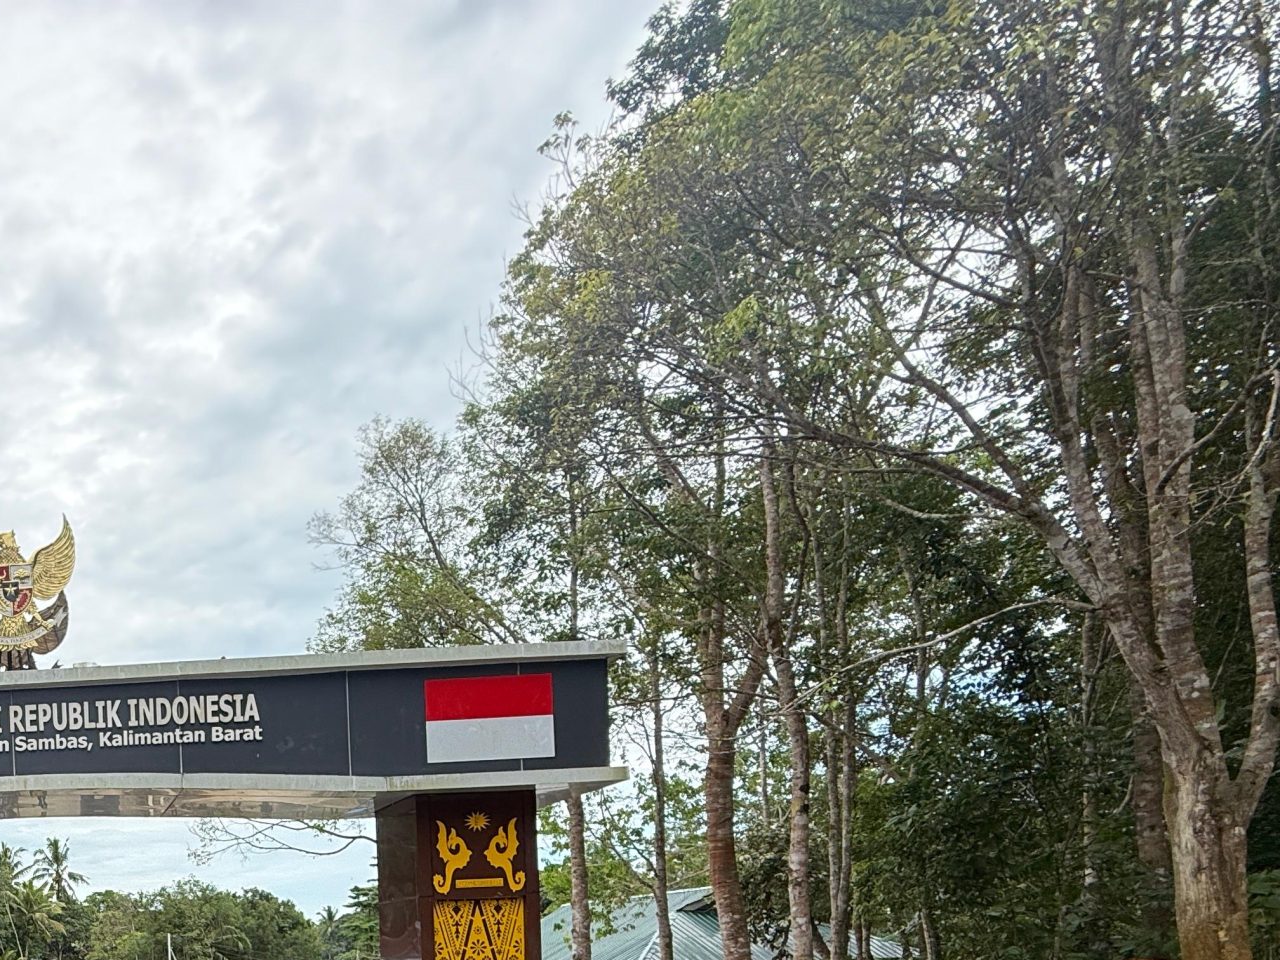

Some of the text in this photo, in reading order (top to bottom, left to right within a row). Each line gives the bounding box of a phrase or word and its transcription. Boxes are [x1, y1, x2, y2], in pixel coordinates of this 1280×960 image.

[9, 699, 123, 733] REPUBLIK
[127, 693, 261, 727] INDONESIA
[14, 733, 93, 752] Sambas,
[99, 727, 205, 748] Kalimantan
[211, 724, 263, 743] Barat
